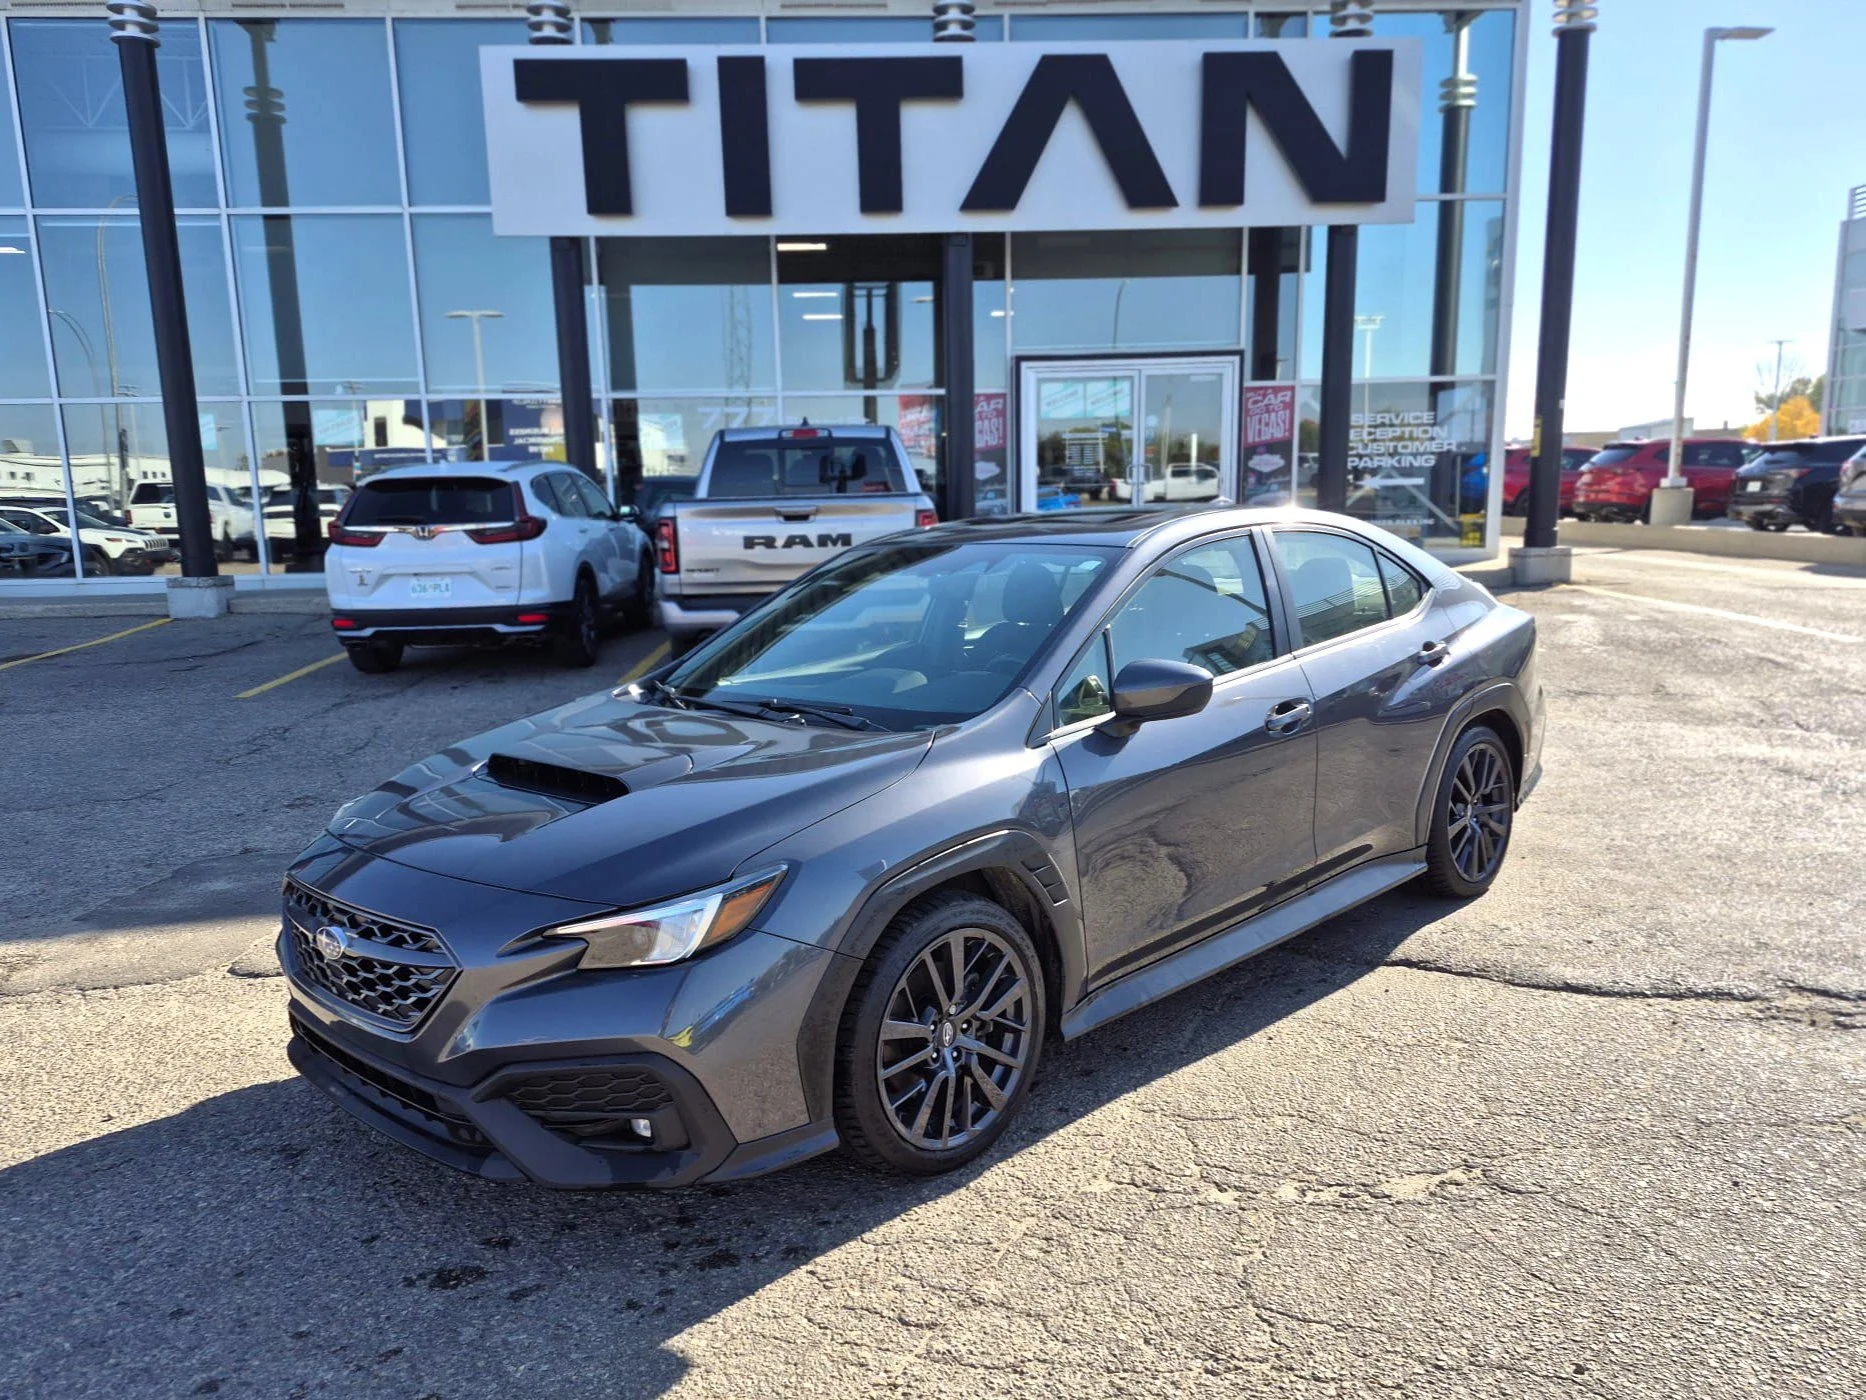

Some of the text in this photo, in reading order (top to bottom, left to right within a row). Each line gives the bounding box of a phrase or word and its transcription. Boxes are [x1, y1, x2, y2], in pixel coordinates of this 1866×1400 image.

[513, 49, 1394, 218] TITAN
[975, 398, 1004, 413] AR
[1248, 391, 1292, 409] CAR
[1350, 411, 1436, 425] SERVICE
[975, 417, 1003, 449] GAS!
[1247, 410, 1291, 443] VEGAS!
[1349, 426, 1448, 440] ECEPTION
[1347, 440, 1457, 454] CUSTOMER
[1346, 455, 1436, 470] PARKING
[743, 533, 852, 550] RAM
